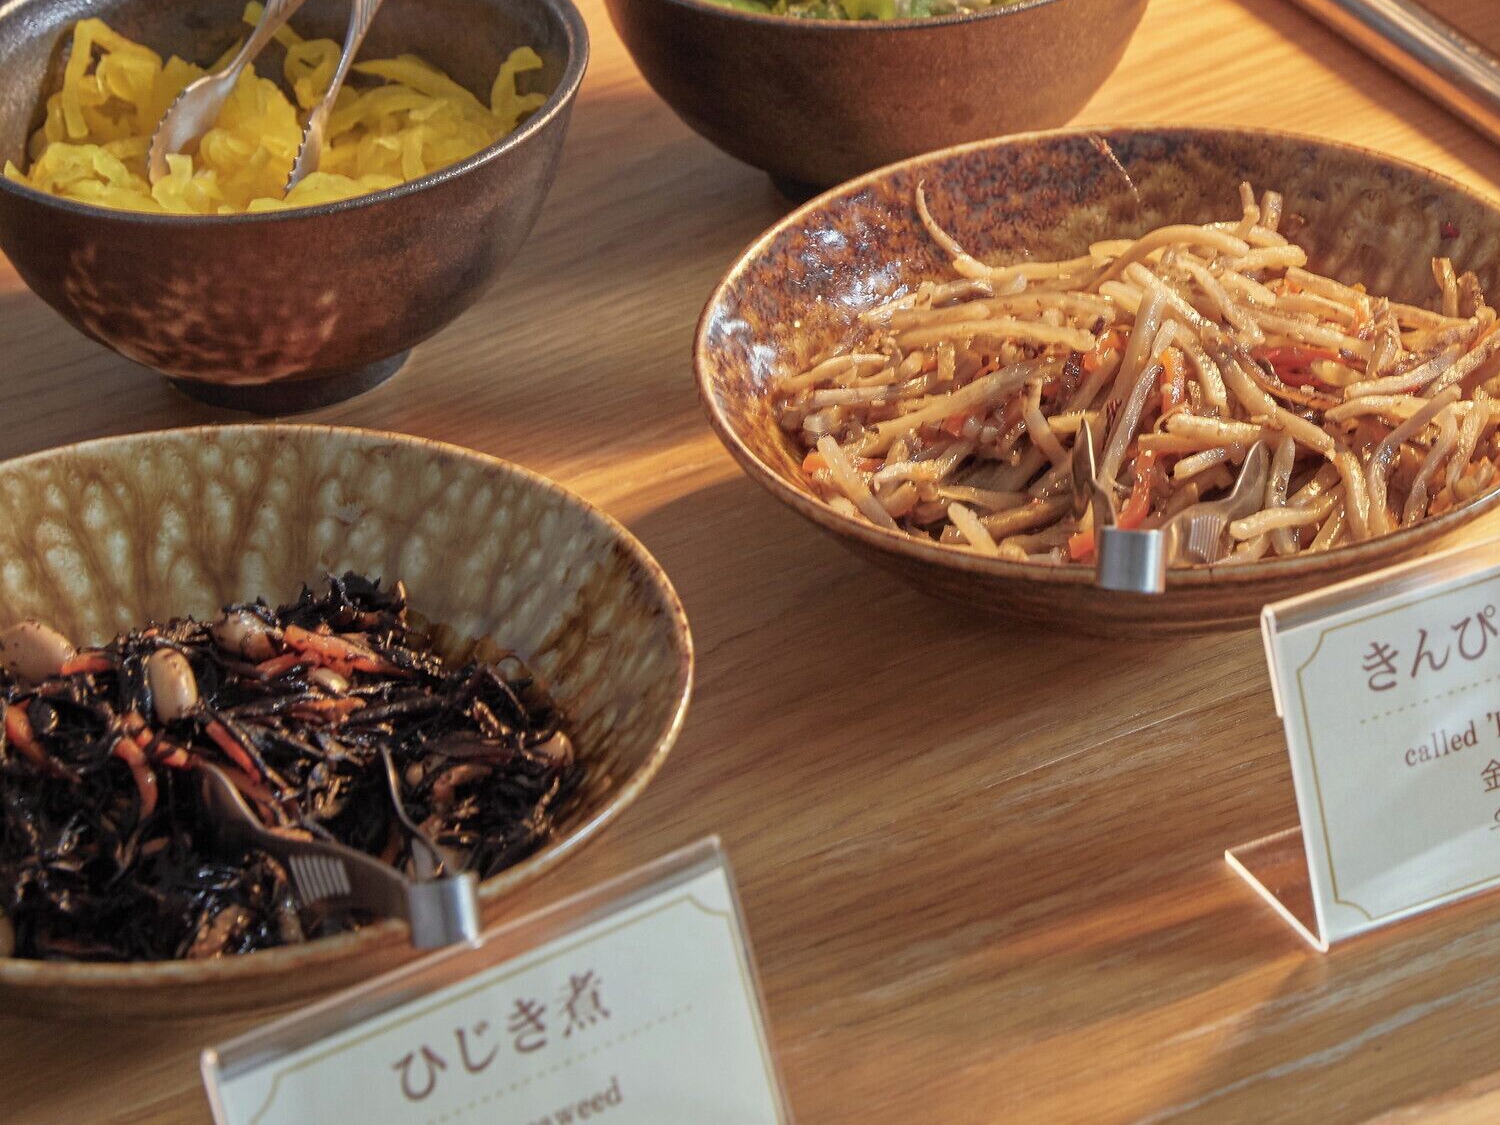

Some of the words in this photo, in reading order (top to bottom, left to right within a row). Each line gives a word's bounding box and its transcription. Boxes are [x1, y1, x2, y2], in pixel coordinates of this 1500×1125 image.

[1405, 720, 1478, 767] called
[390, 969, 611, 1101] ひじき煮
